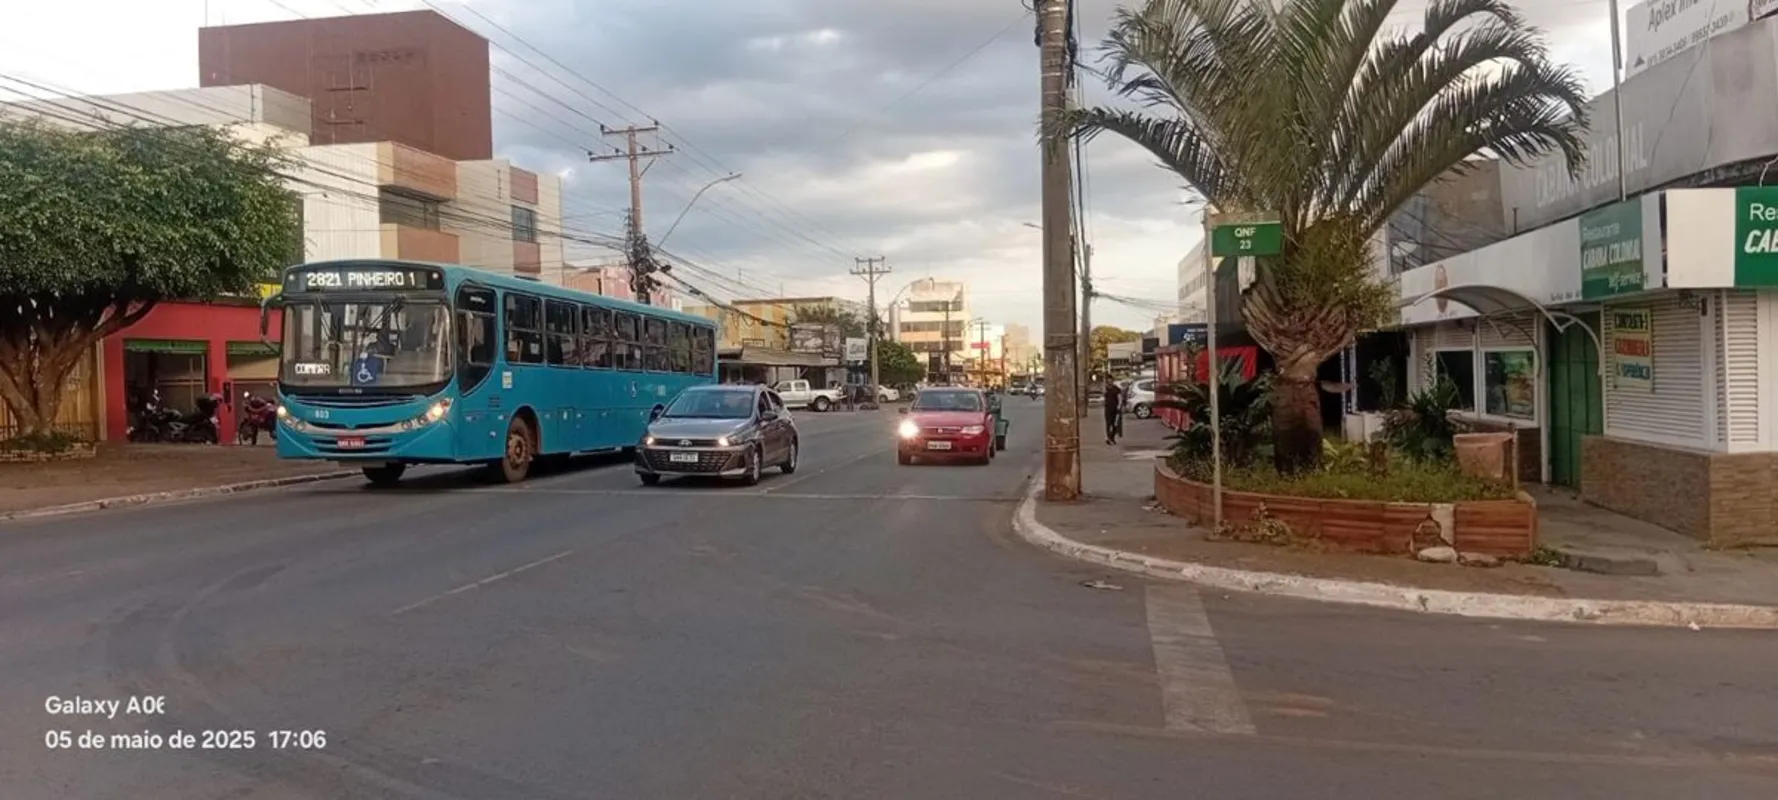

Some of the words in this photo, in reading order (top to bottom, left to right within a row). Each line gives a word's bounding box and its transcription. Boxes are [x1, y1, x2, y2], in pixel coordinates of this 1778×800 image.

[1749, 202, 1778, 221] Re
[1234, 227, 1256, 238] QNF
[1240, 240, 1252, 250] 23
[307, 272, 342, 286] 2821
[347, 272, 404, 286] PINHEIRO
[408, 272, 416, 286] 1
